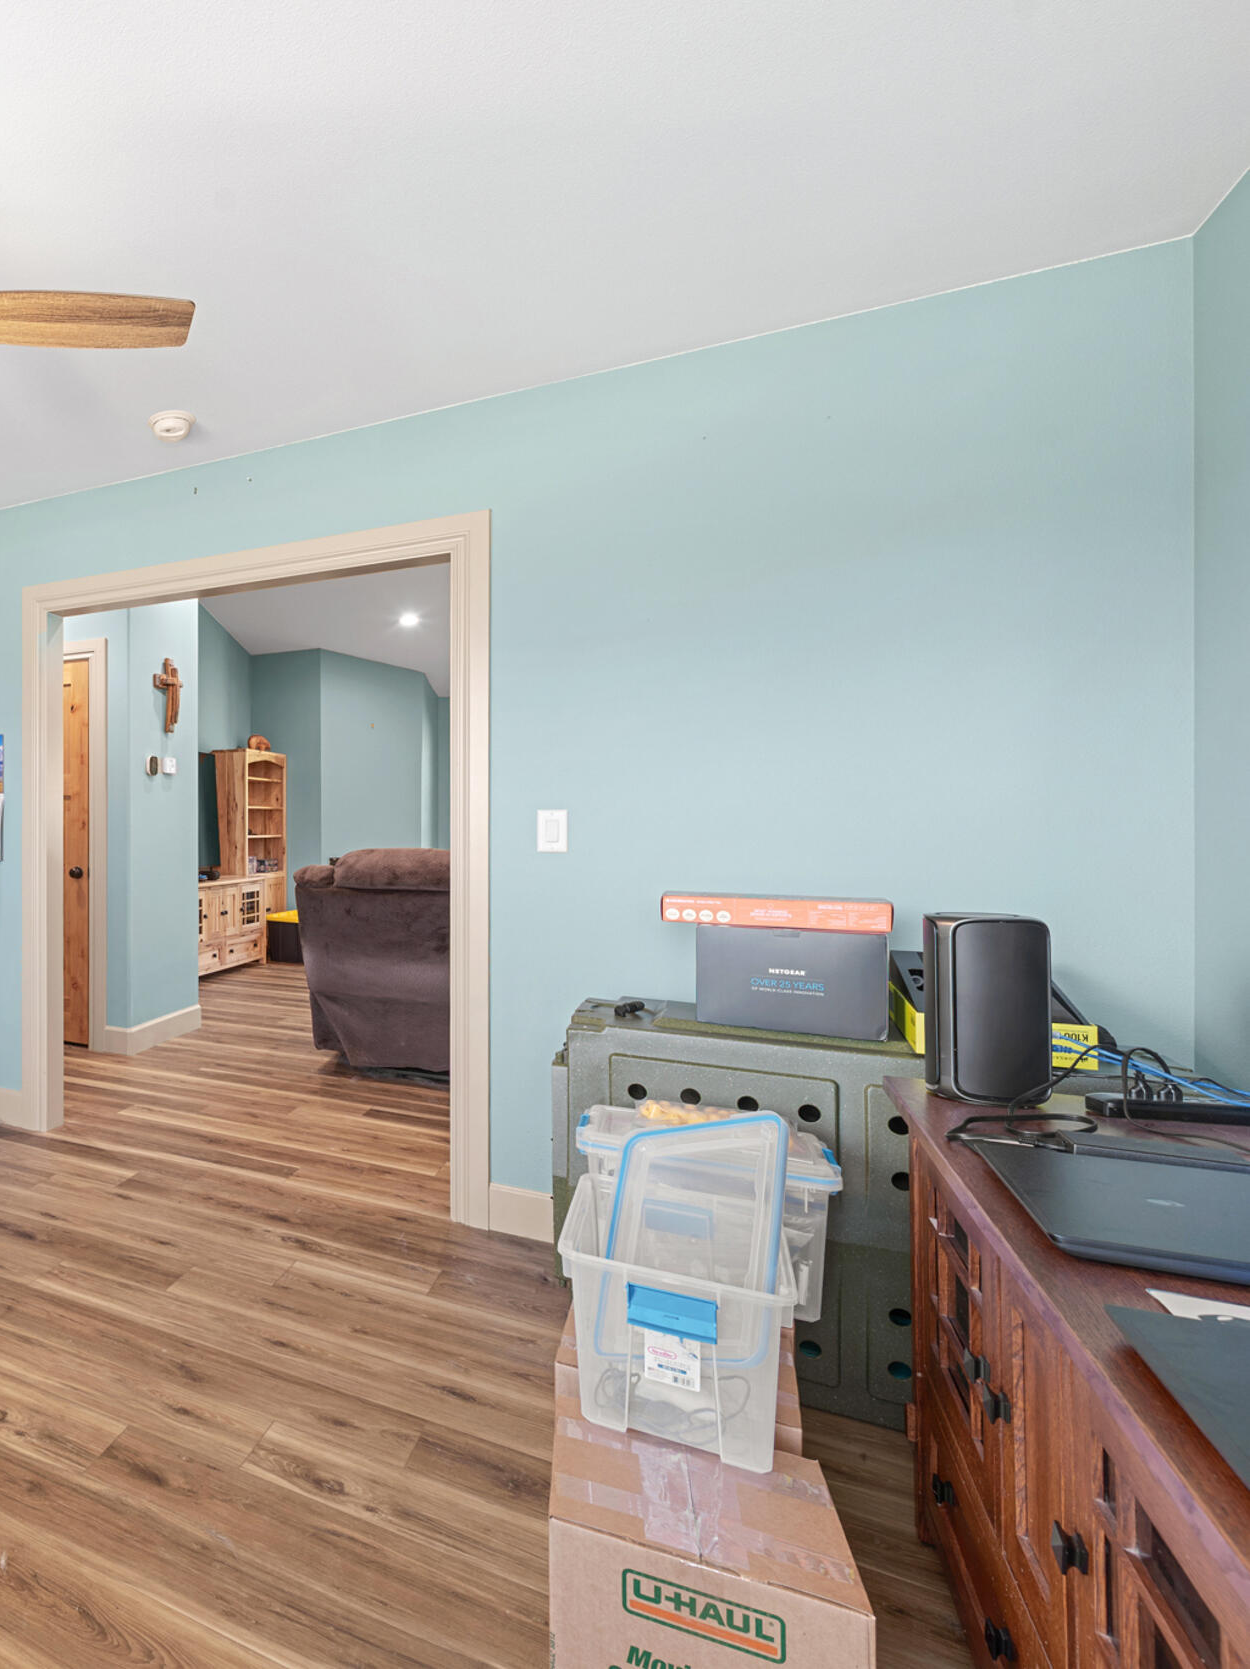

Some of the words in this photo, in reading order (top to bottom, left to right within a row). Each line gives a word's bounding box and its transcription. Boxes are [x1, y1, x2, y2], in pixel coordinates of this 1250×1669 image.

[768, 968, 806, 976] NETGEAR
[750, 977, 777, 987] OVER
[779, 980, 791, 989] 25
[793, 981, 825, 991] YEARS
